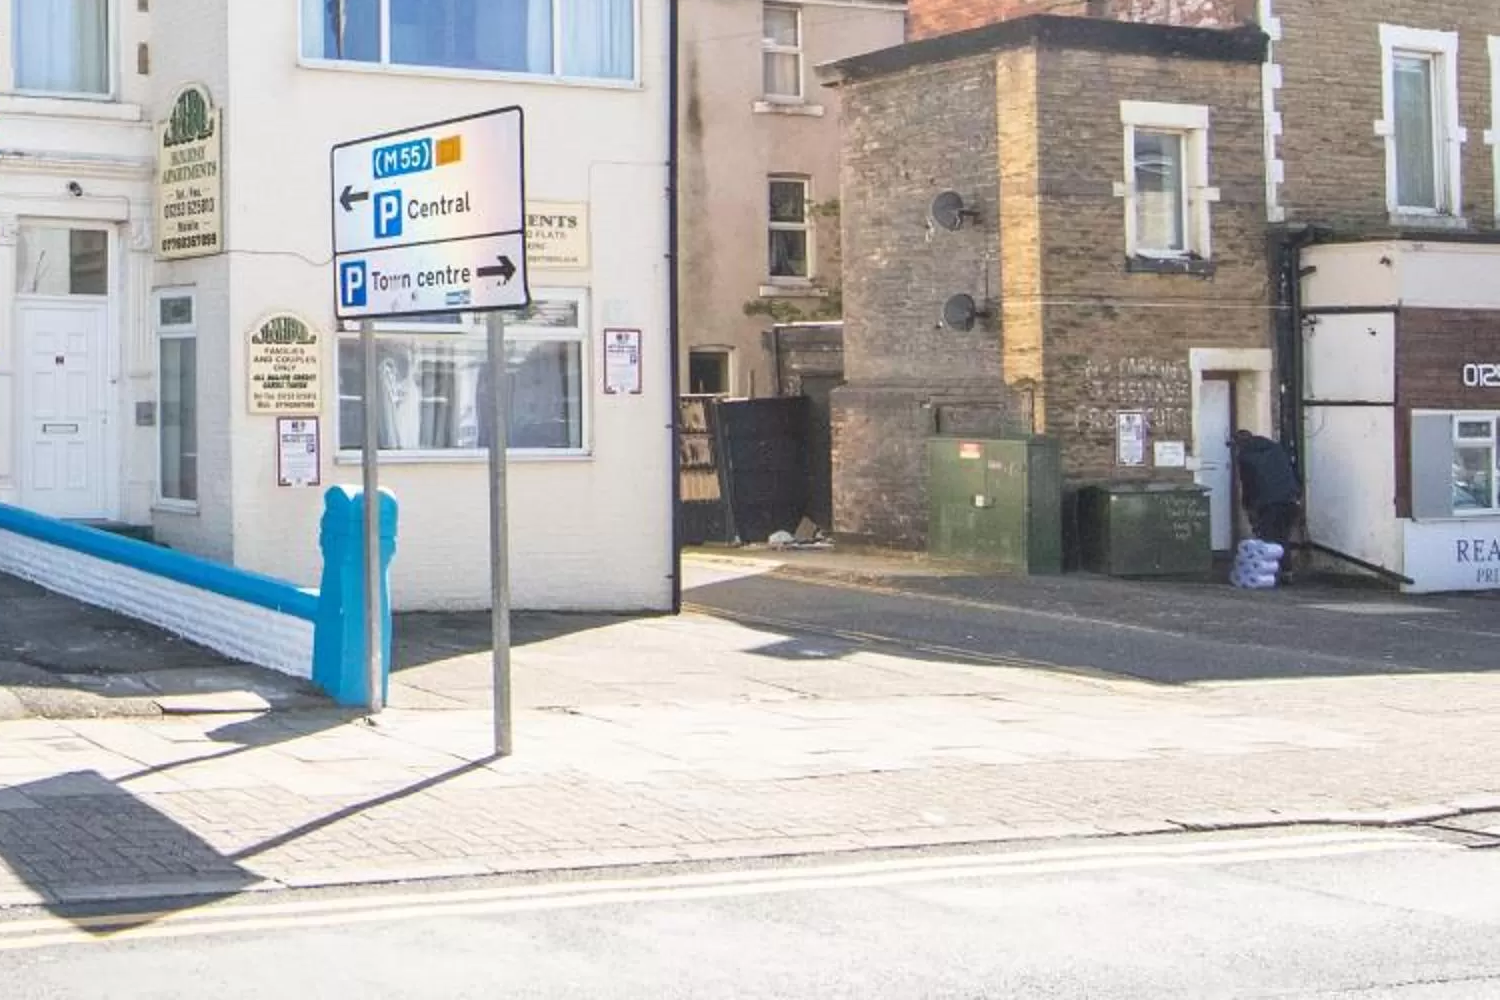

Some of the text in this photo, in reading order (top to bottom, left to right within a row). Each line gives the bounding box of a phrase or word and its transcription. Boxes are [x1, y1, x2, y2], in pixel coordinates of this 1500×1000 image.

[162, 161, 217, 184] APARTMENTS
[407, 191, 471, 220] Central
[527, 214, 578, 228] ENTS
[417, 265, 471, 288] centre
